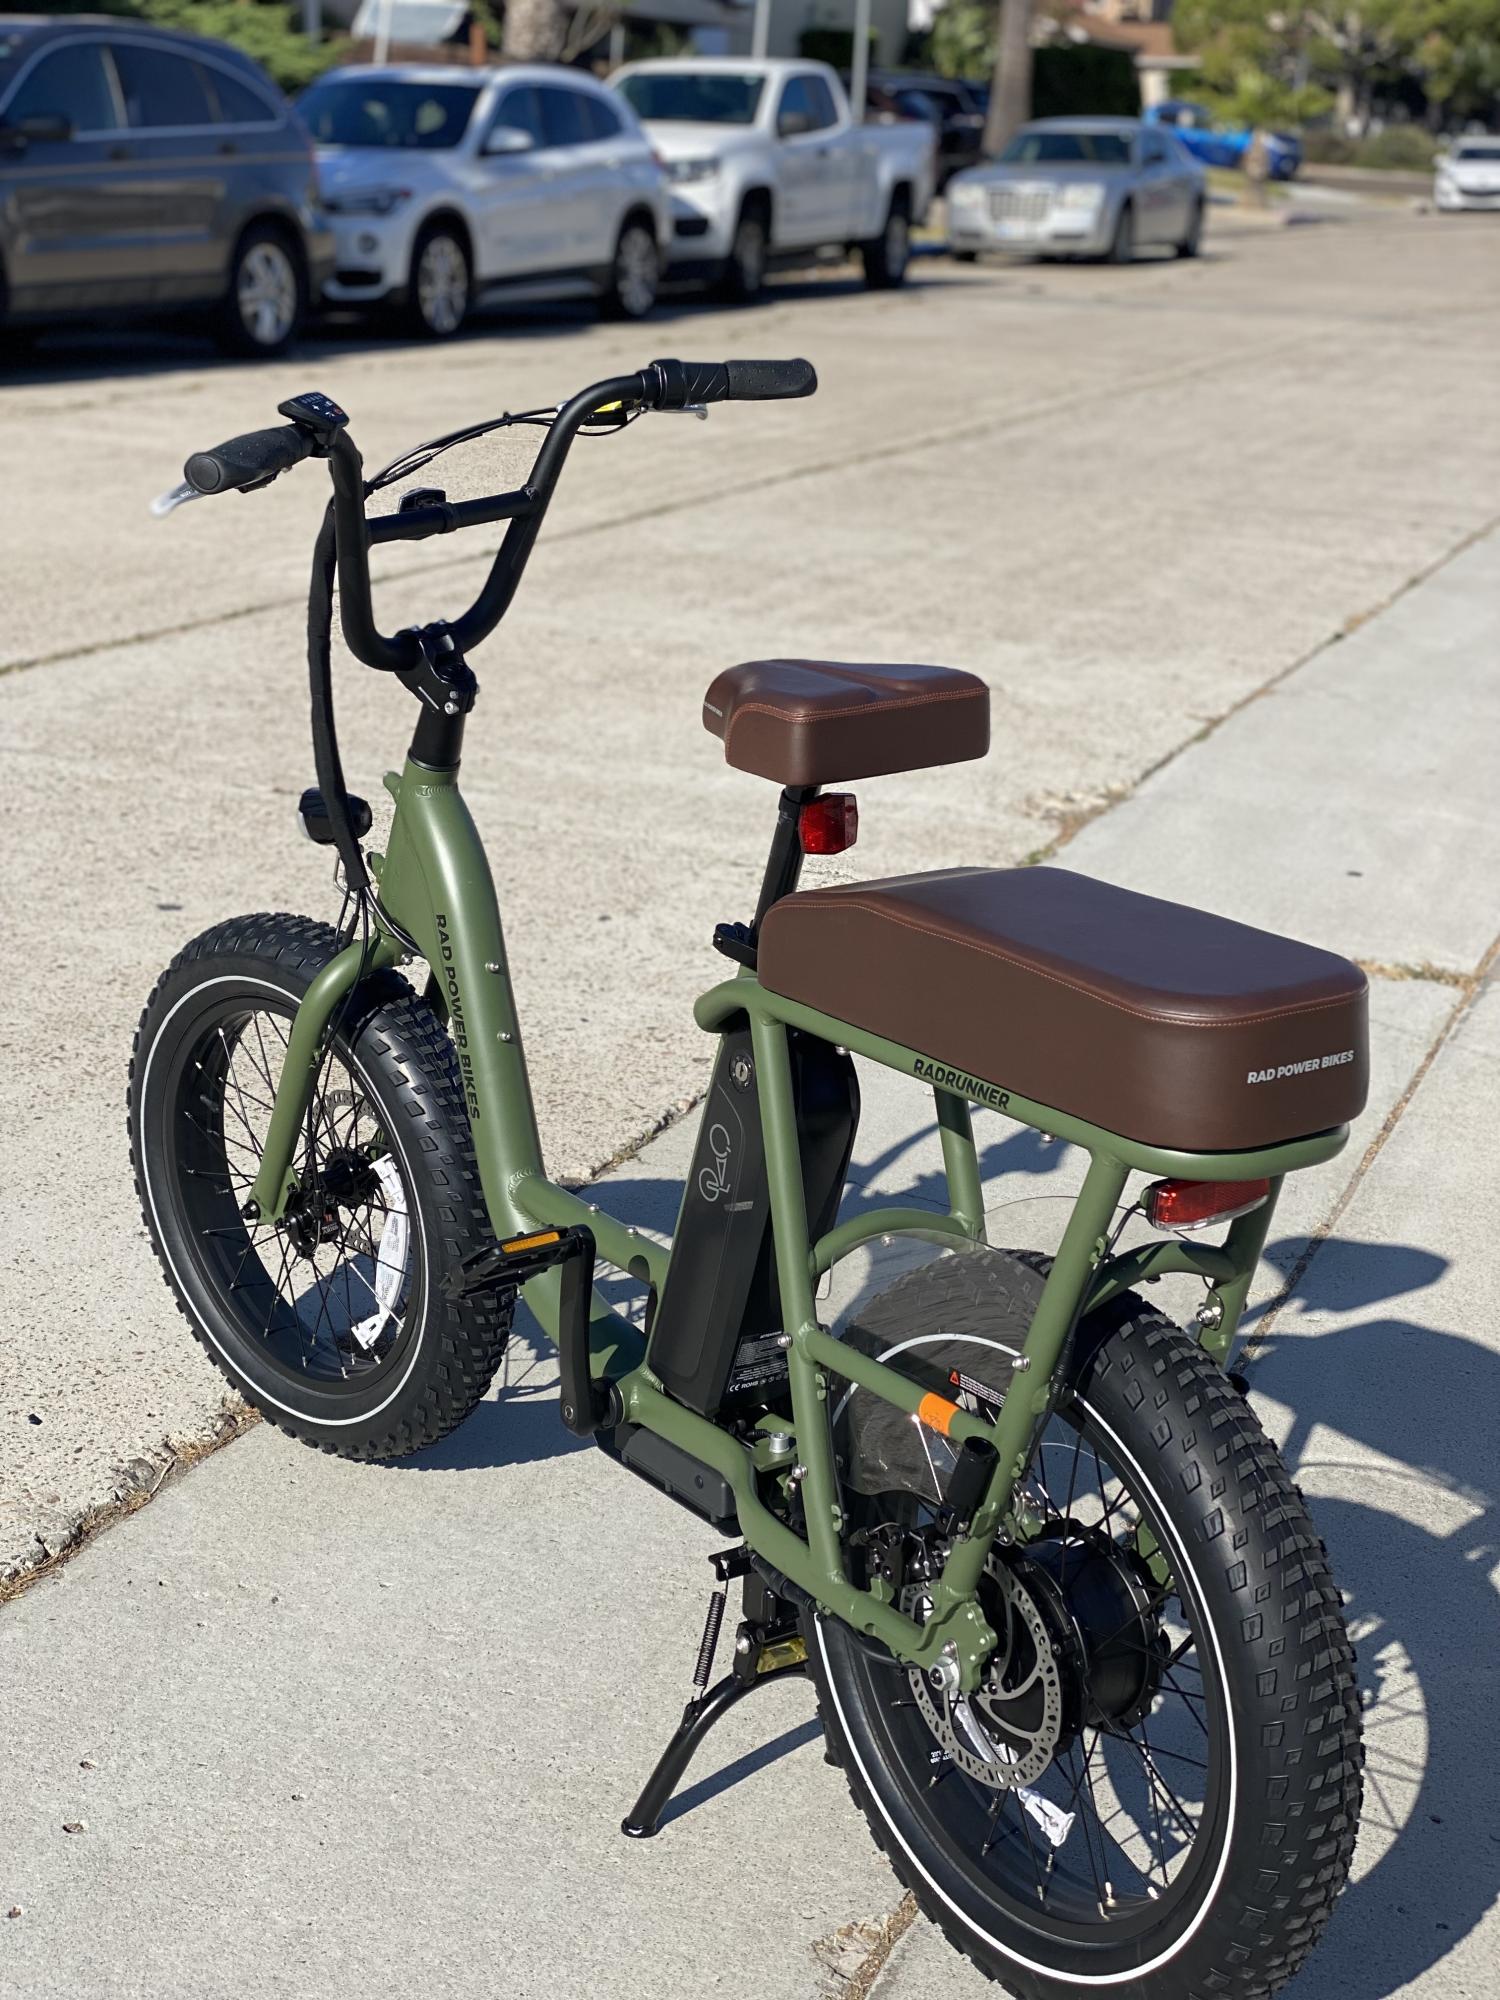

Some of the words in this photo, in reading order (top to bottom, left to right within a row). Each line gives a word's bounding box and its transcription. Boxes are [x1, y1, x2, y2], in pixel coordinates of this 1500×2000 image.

[436, 914, 453, 961] RAD
[445, 967, 468, 1049] POWER
[461, 1055, 480, 1119] BIKES
[914, 1059, 1010, 1110] RADRUNNER
[1247, 1068, 1276, 1084] RAD
[1277, 1058, 1320, 1079] POWER
[1321, 1050, 1355, 1069] BIKES
